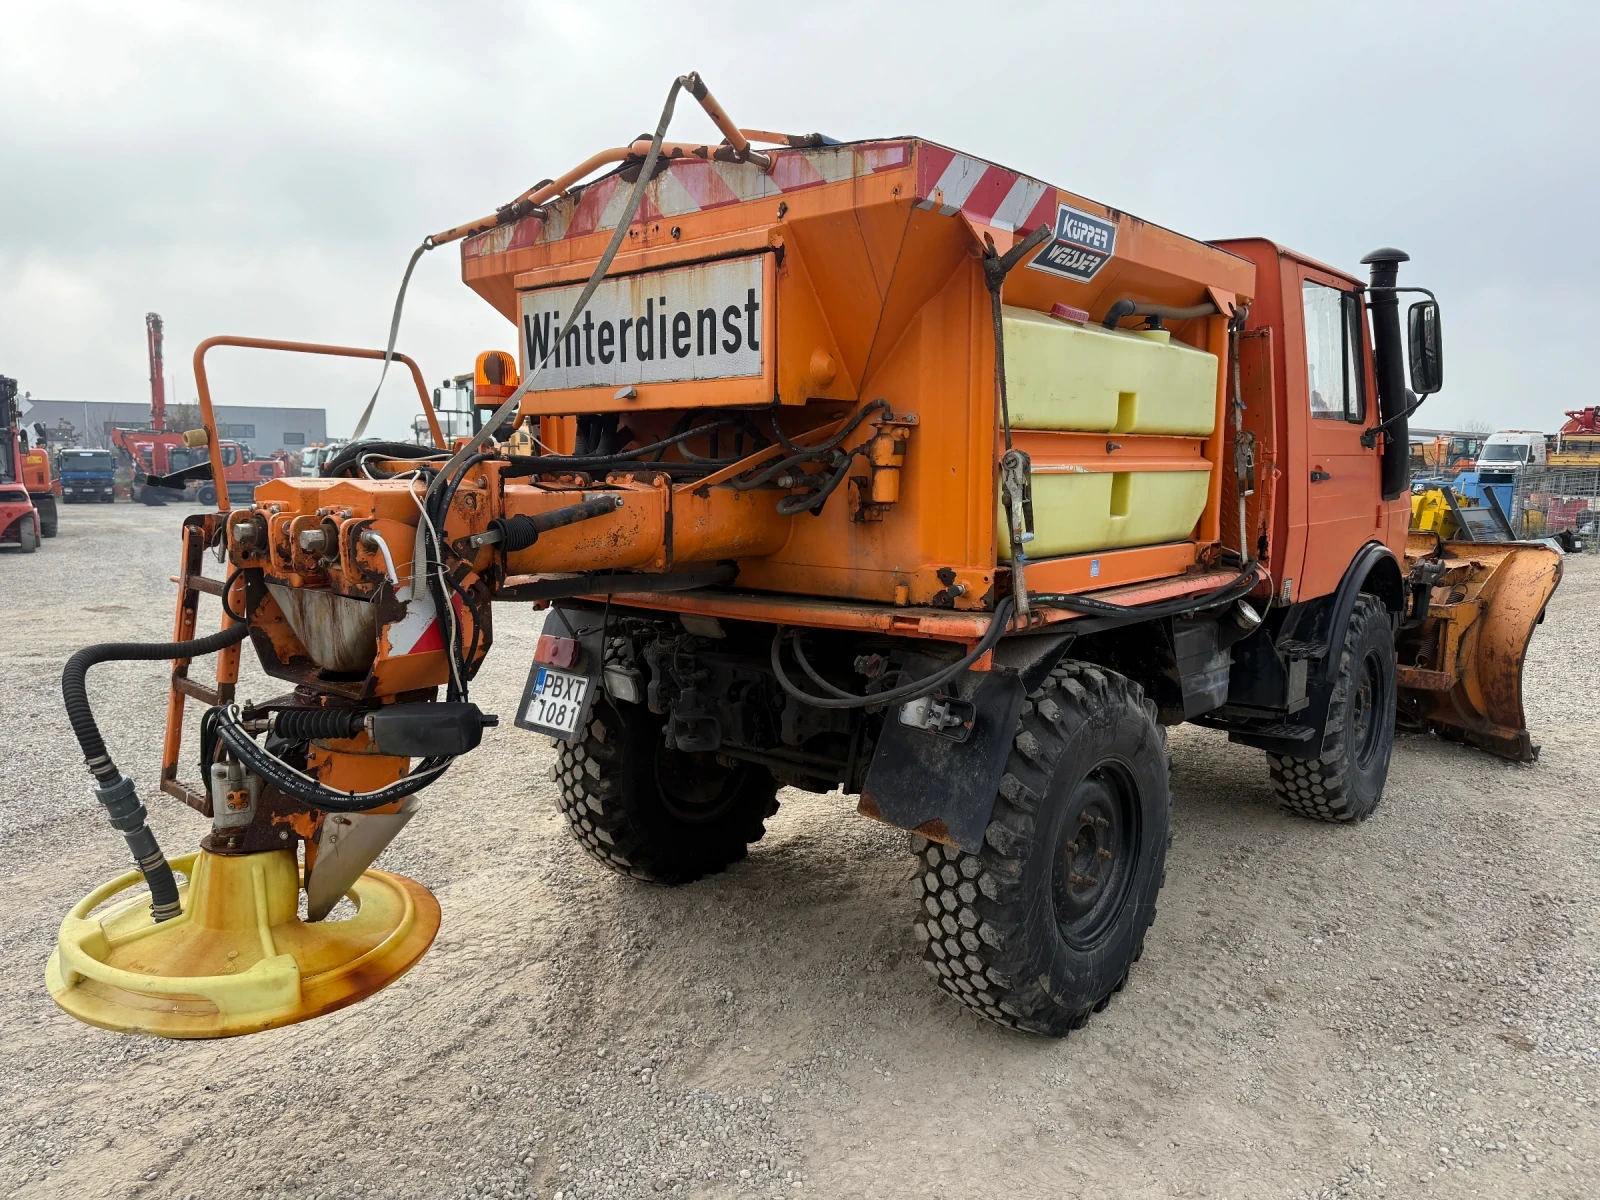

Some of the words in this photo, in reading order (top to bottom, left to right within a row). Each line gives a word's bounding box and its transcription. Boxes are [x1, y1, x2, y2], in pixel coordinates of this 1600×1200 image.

[1062, 213, 1109, 249] KÜPPER
[1046, 244, 1102, 273] WEISSER
[523, 287, 760, 371] Winterdienst
[538, 699, 577, 729] 1081
